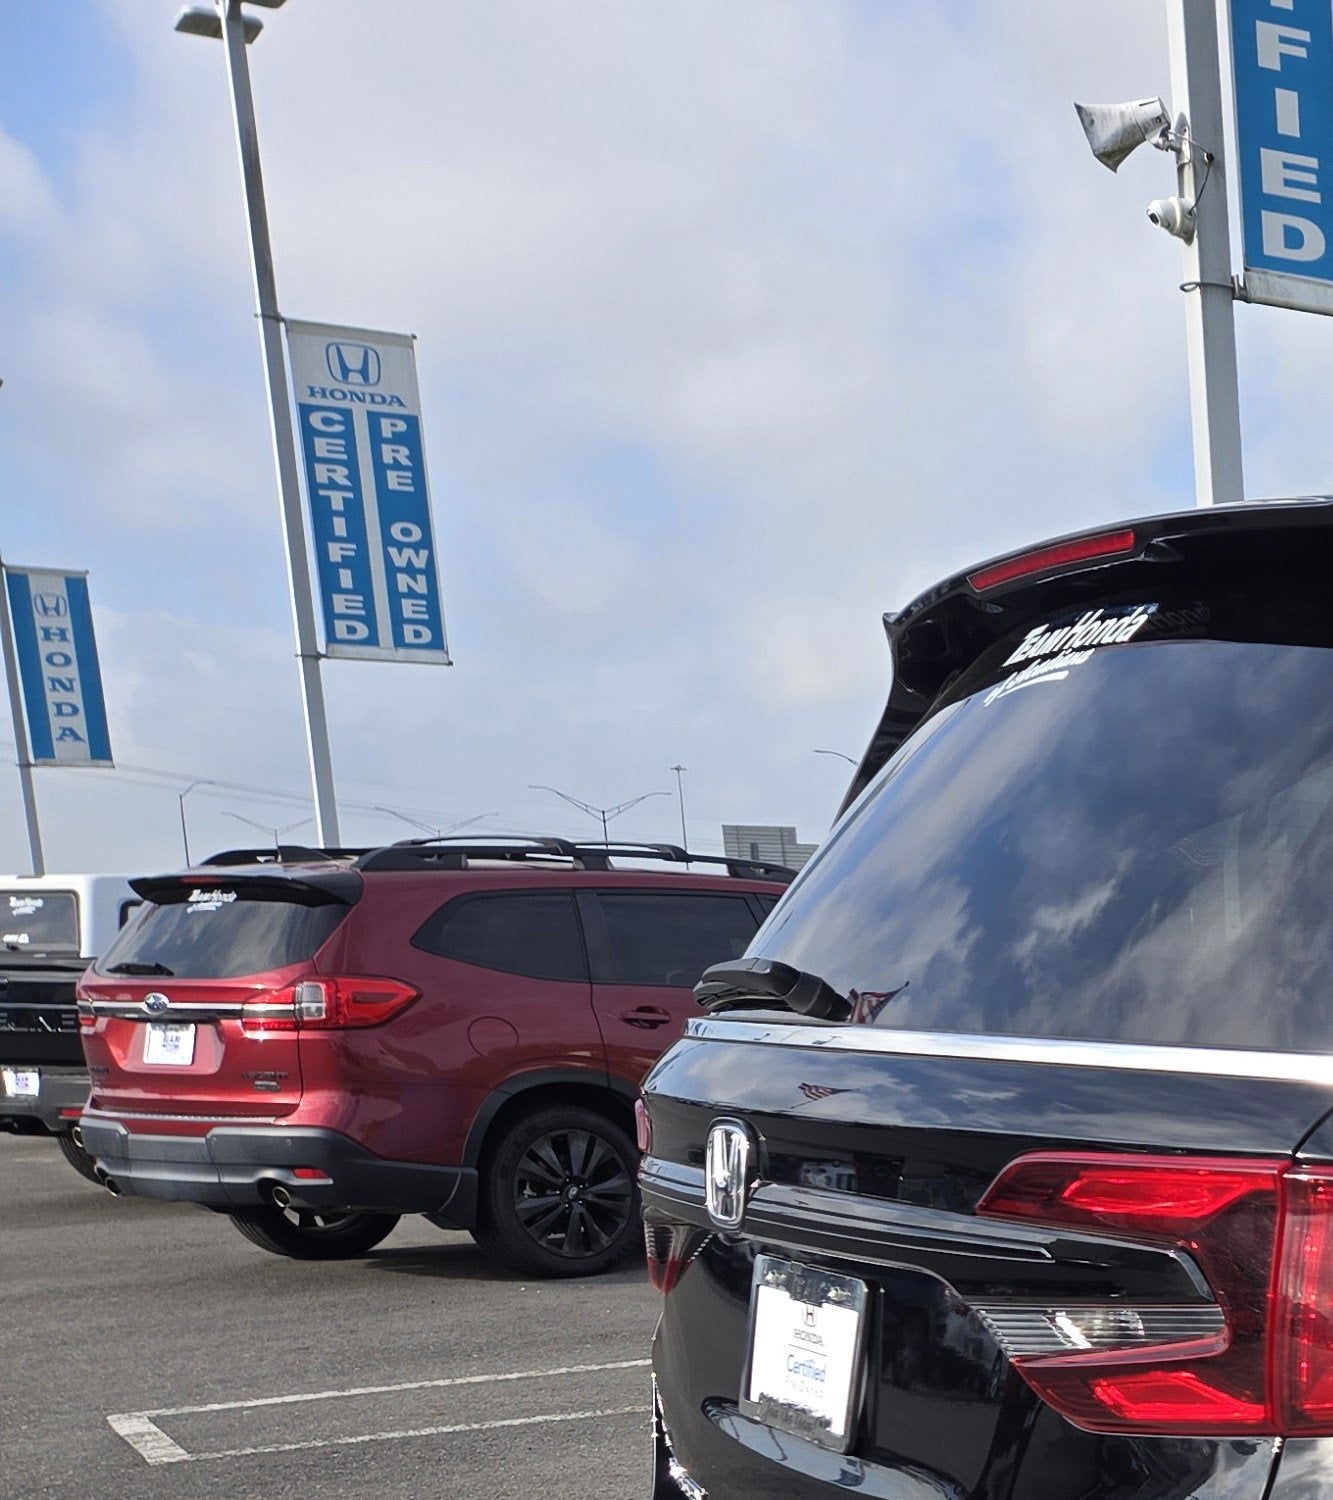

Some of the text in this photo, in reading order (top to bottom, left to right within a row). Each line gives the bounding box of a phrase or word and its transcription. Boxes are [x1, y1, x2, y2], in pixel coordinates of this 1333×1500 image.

[1255, 0, 1326, 262] FIED
[307, 385, 407, 408] HONDA
[308, 410, 370, 641] CERTIFIED
[379, 417, 433, 646] PRE OWNED
[39, 626, 85, 742] HONDA
